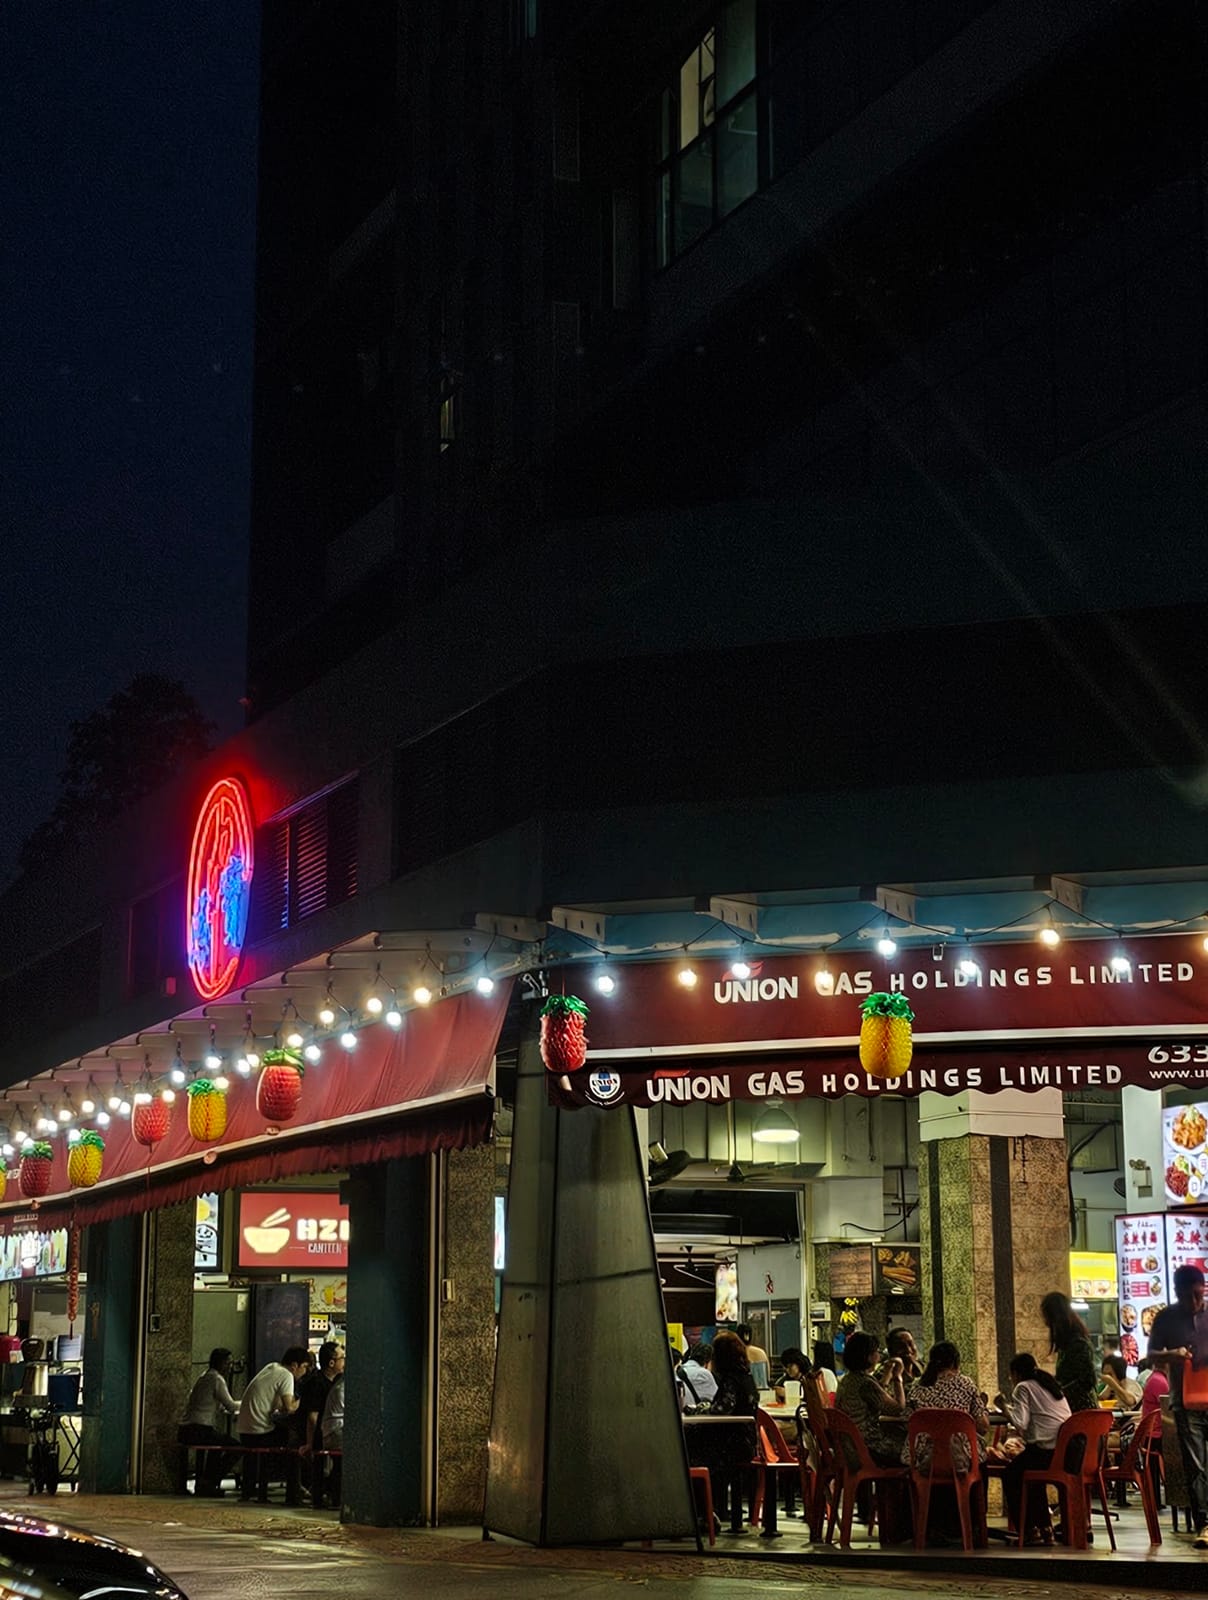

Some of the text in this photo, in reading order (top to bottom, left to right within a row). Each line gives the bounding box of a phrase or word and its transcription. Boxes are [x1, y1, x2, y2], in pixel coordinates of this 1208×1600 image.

[714, 976, 798, 1003] UNION
[890, 967, 1052, 991] HOLDINGS
[1070, 963, 1194, 984] LIMITED
[647, 1065, 1122, 1102] UNION GAS HOLDINGS LIMITED
[1149, 1070, 1208, 1079] www.u
